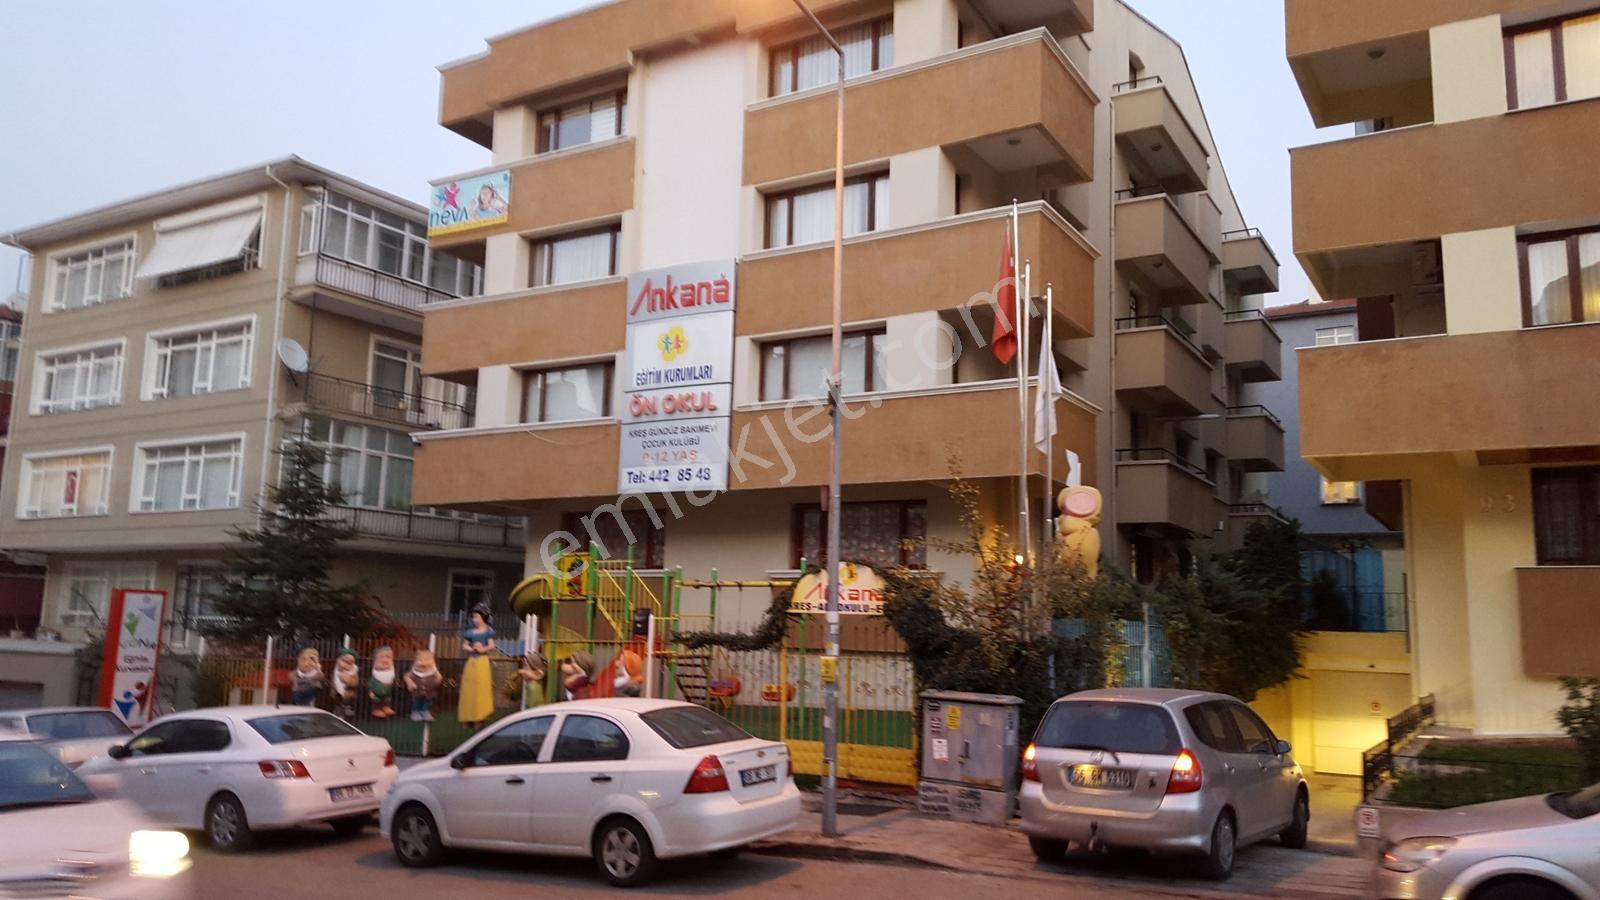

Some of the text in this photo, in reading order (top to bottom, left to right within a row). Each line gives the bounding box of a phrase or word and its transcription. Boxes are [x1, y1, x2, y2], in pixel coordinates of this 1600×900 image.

[630, 274, 730, 316] Ankana
[636, 365, 713, 386] EĞİTİM KURUMLARI
[630, 391, 717, 418] ÖN OKUL
[626, 471, 646, 484] Tel:
[648, 469, 670, 482] 442
